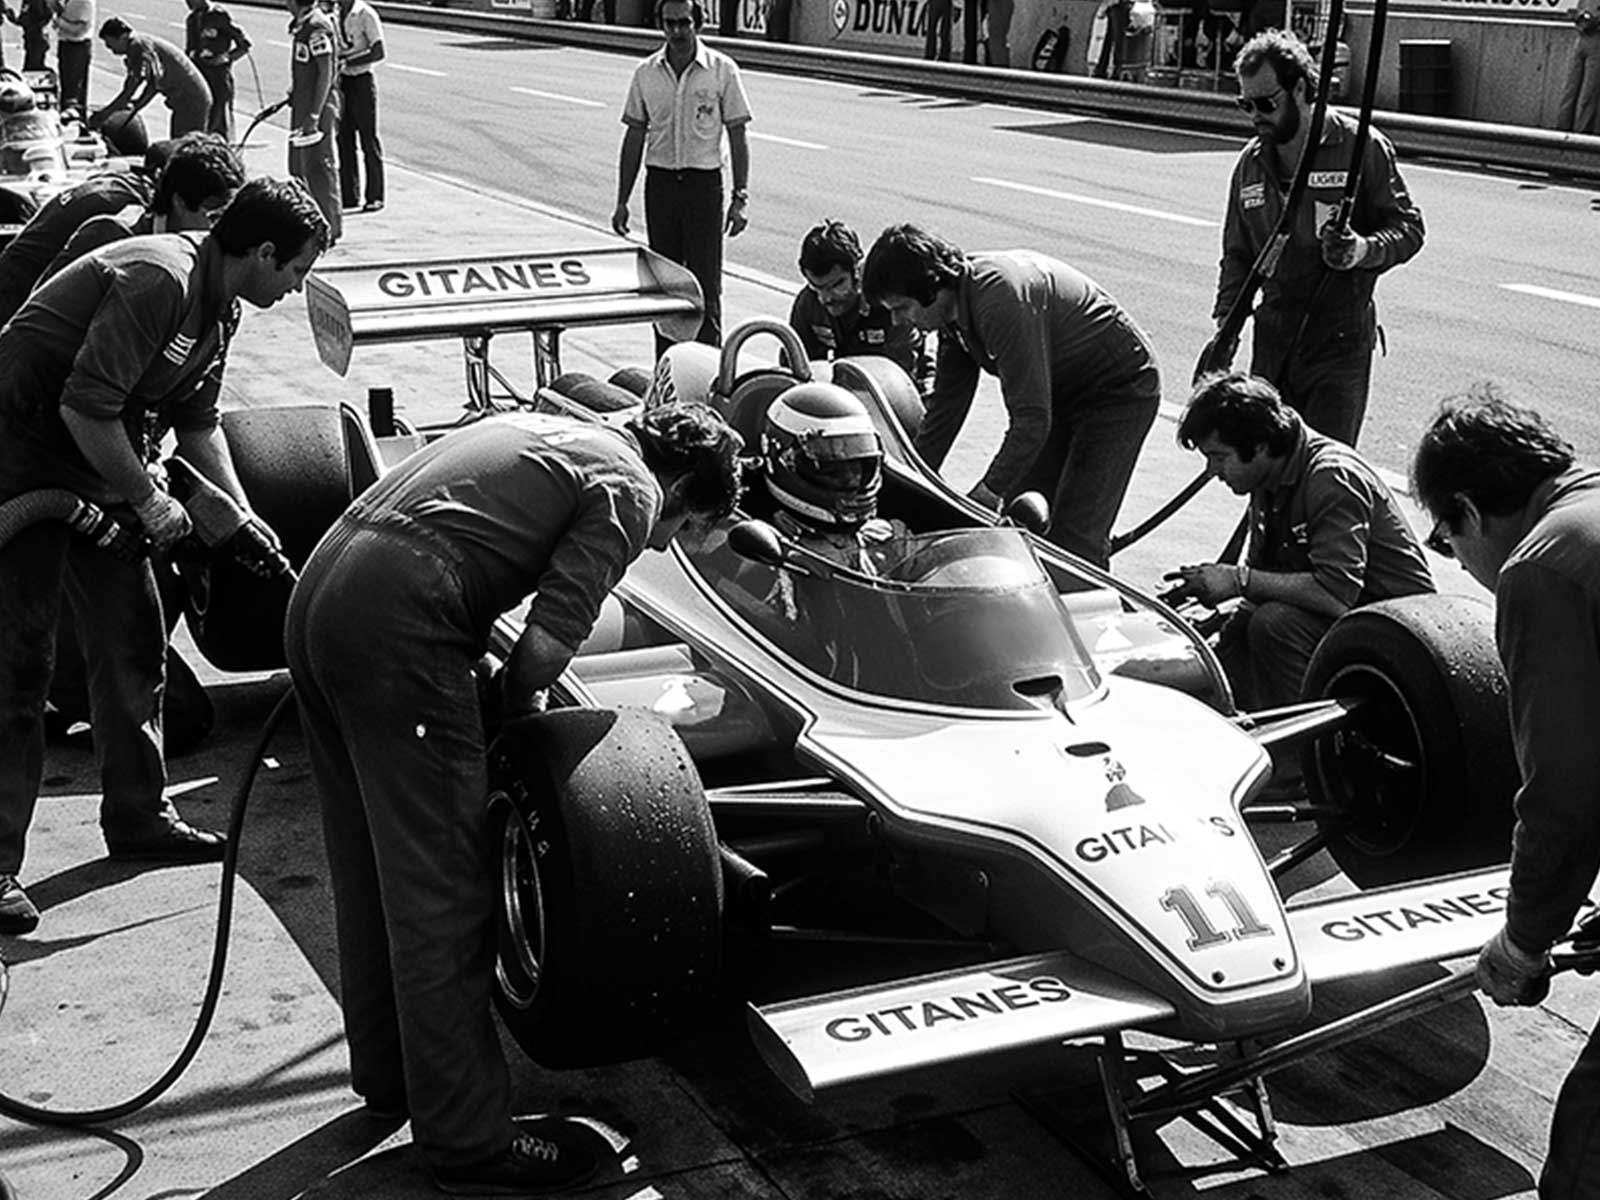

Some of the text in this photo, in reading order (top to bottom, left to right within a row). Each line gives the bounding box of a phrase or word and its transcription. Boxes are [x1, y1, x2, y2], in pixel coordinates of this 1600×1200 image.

[852, 0, 928, 37] DUNL
[378, 260, 591, 298] GITANES
[1075, 816, 1236, 863] GITAS
[1158, 880, 1276, 952] 11
[825, 979, 1071, 1042] GITANES
